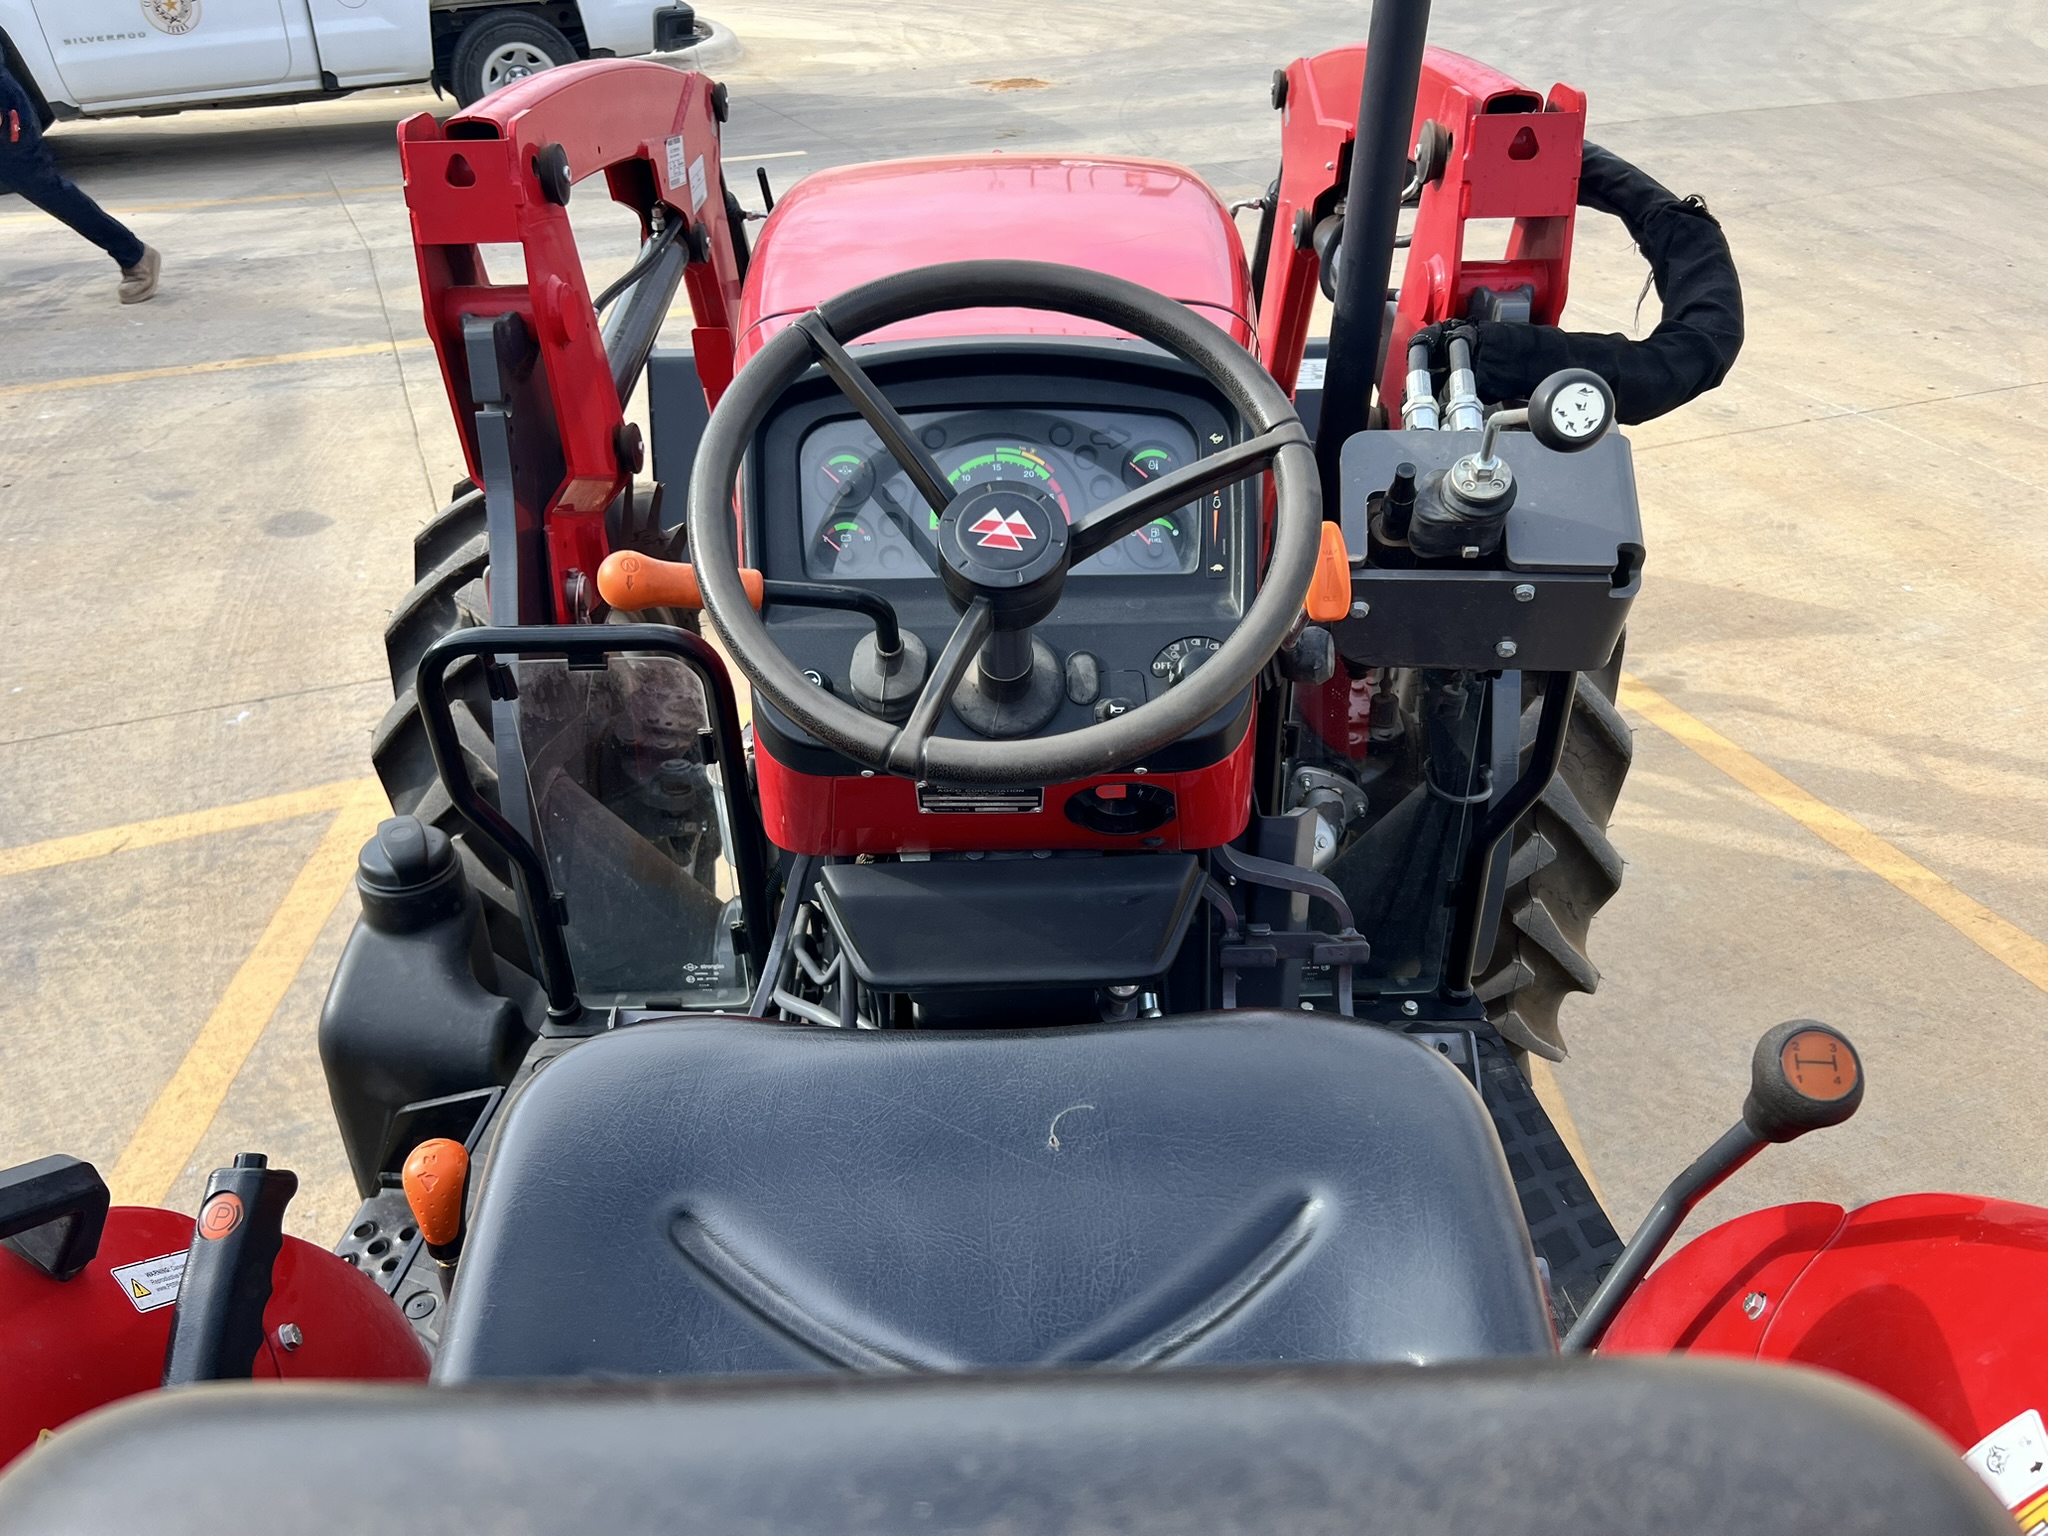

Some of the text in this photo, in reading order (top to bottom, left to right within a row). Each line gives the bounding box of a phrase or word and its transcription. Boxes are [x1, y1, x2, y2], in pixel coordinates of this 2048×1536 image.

[167, 23, 189, 33] TEXAS
[63, 32, 147, 45] SILVERADO
[961, 474, 971, 482] 10
[1023, 470, 1035, 478] 20
[1152, 661, 1172, 670] OFF
[1791, 1041, 1838, 1053] 2 3
[212, 1206, 231, 1227] P
